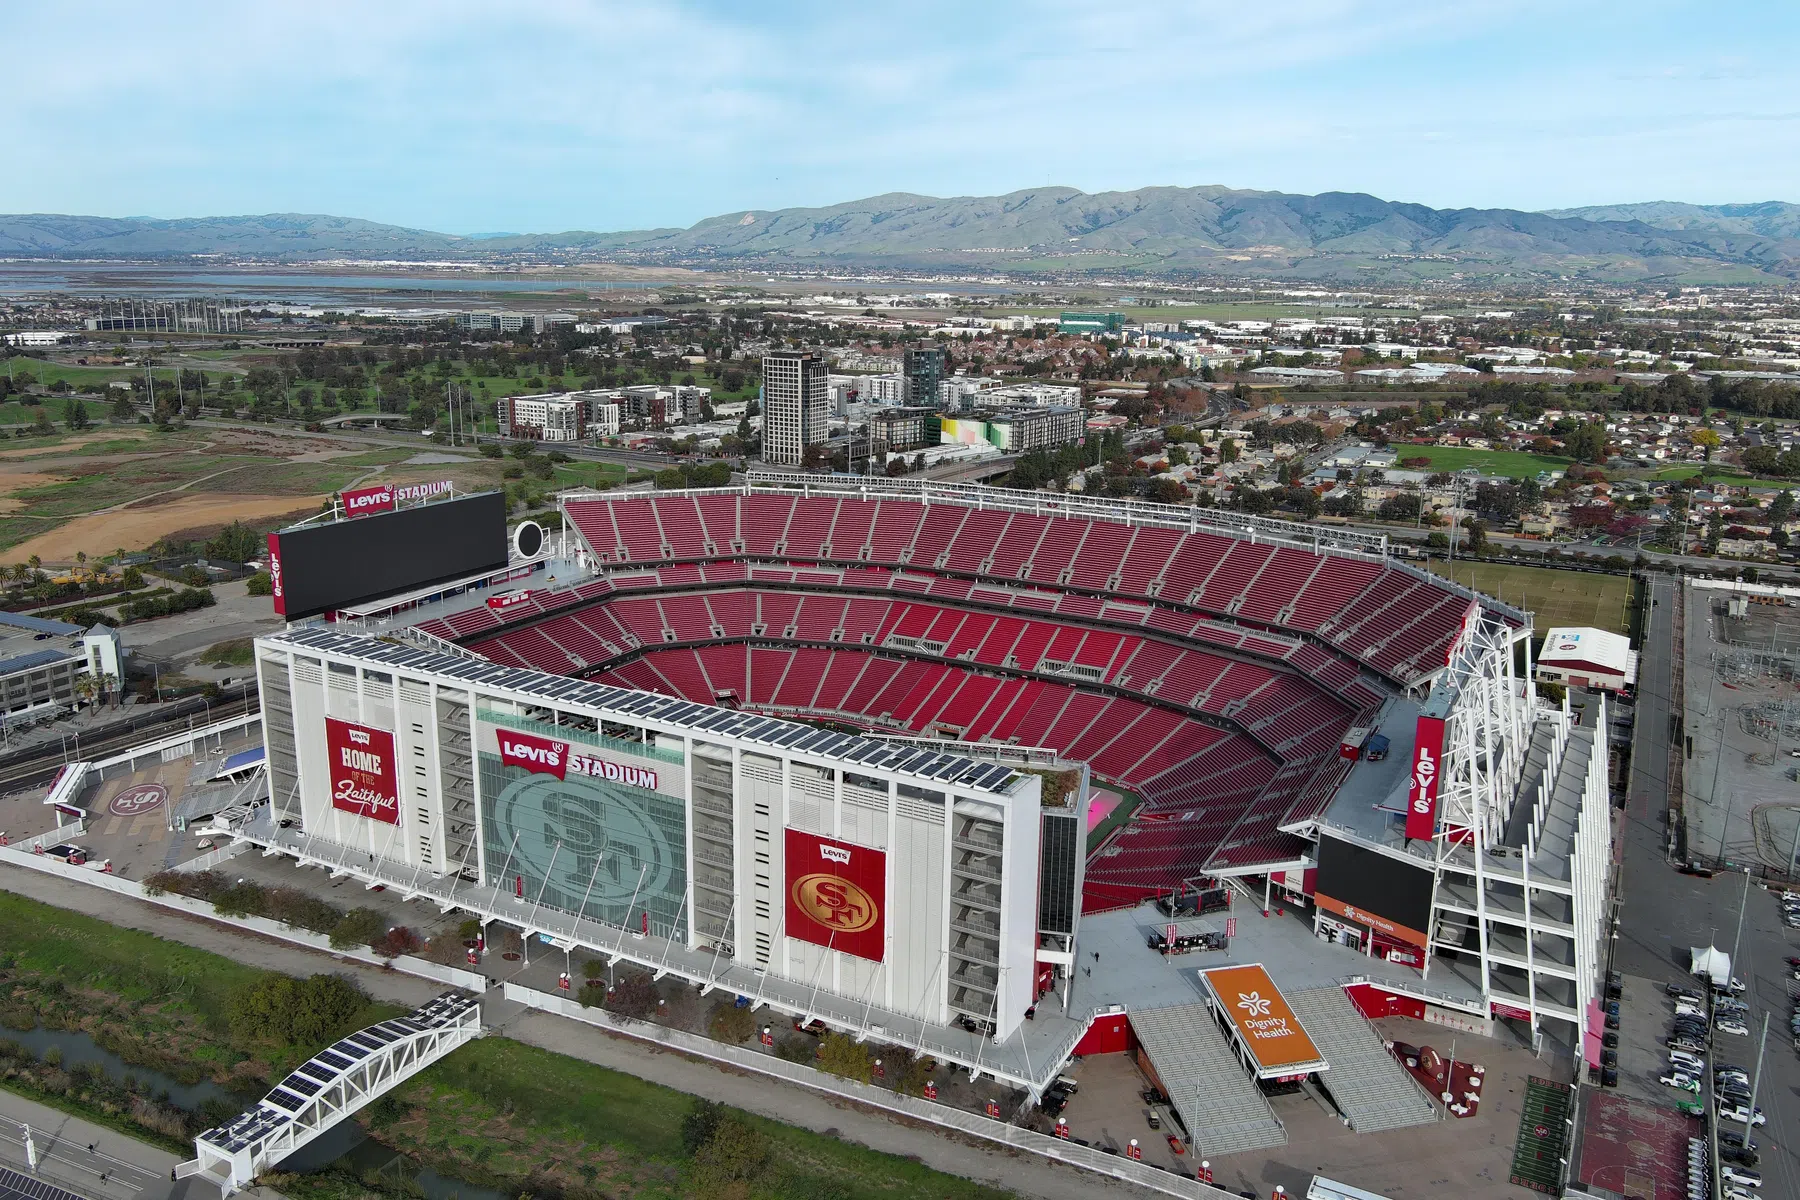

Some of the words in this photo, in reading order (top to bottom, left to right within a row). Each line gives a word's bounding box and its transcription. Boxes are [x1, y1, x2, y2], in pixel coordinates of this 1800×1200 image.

[397, 481, 452, 500] STADIUM
[341, 746, 382, 776] HOME
[352, 770, 359, 781] OF
[361, 773, 375, 786] THE
[571, 755, 657, 790] STADIUM
[335, 779, 396, 813] Faithful
[1356, 912, 1376, 925] Dignity
[1375, 920, 1394, 932] Health
[1244, 1017, 1286, 1030] Dignity
